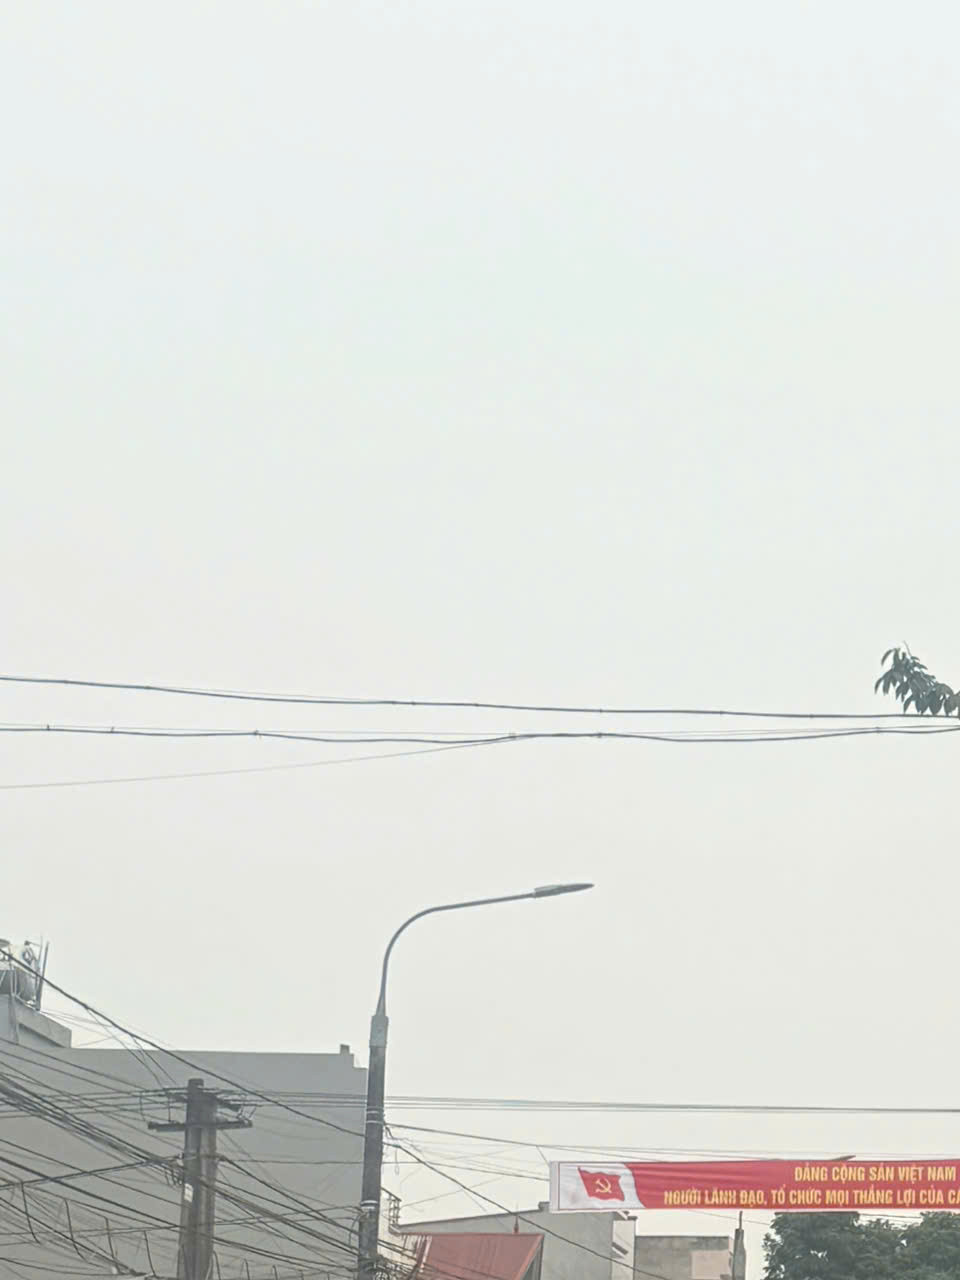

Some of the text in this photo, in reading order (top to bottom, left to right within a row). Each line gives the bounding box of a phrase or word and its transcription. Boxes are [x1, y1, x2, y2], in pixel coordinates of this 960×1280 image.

[794, 1162, 957, 1184] ĐẢNG CỘNG SẢN VIỆT NAM
[664, 1186, 702, 1205] NGƯỜI
[704, 1186, 737, 1205] LÃNH
[771, 1183, 787, 1205] TỔ
[789, 1186, 822, 1205] CHỨC
[825, 1189, 850, 1207] MỌI
[853, 1184, 893, 1205] THẮNG
[896, 1188, 916, 1207] LỢI
[919, 1184, 944, 1204] CỦA
